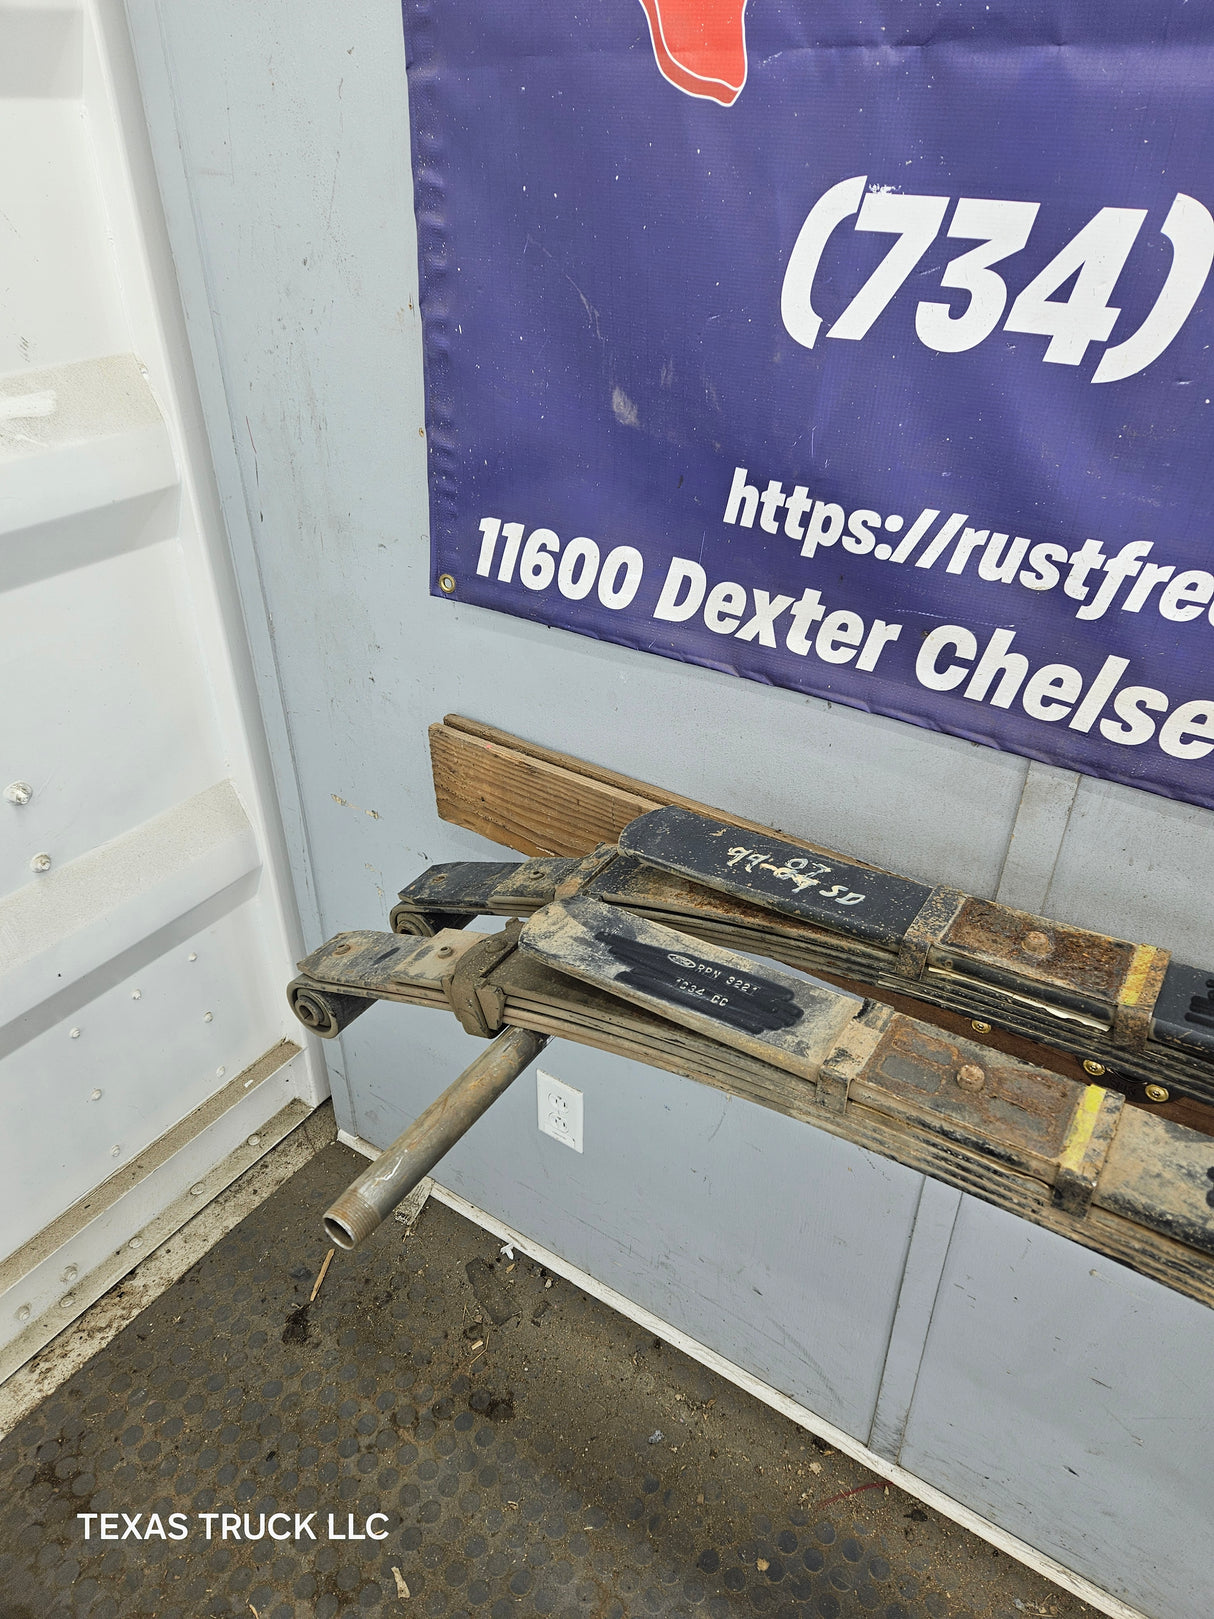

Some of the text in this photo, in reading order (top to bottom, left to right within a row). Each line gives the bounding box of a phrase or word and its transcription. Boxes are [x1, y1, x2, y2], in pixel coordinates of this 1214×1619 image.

[780, 175, 1214, 384] (734)
[475, 517, 1214, 760] 11600 Dexter Chelse
[723, 467, 1214, 627] https://rustfre
[819, 885, 866, 905] SD
